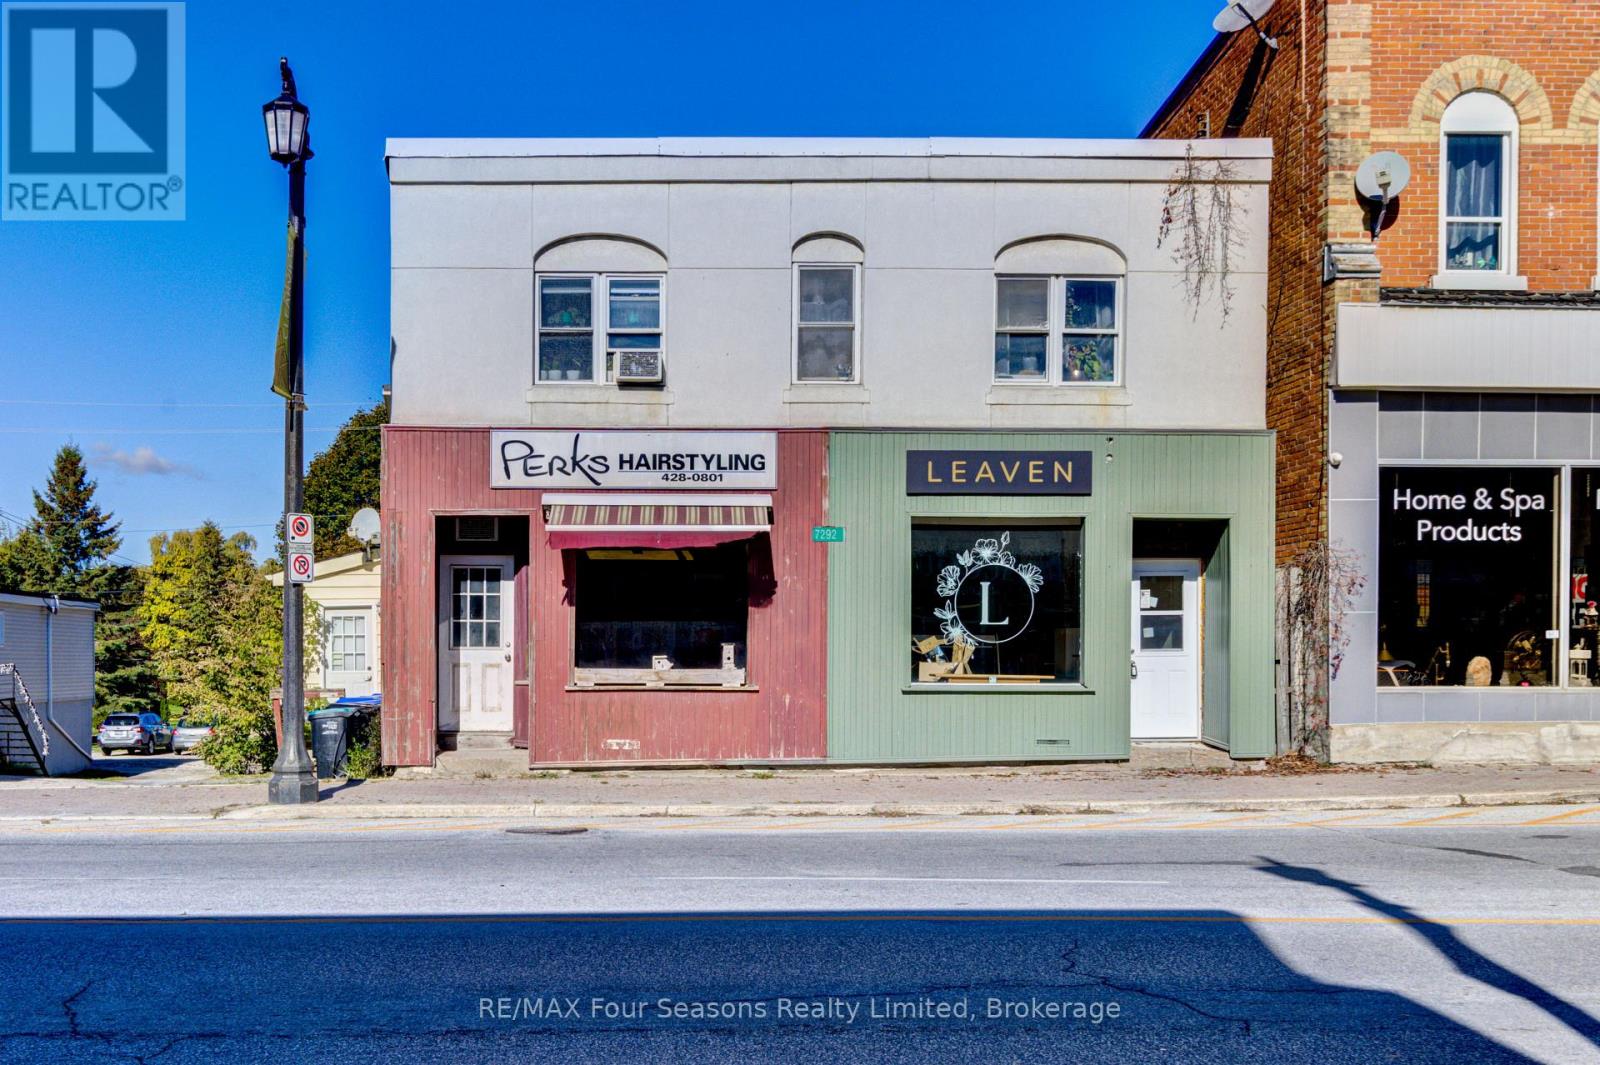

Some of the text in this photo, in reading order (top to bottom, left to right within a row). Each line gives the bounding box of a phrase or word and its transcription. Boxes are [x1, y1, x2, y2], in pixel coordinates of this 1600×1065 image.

[618, 453, 767, 471] HAIRSTYLING
[926, 460, 1074, 483] LEAVEN
[661, 473, 724, 482] 428-0801
[1393, 487, 1545, 517] Home & Spa
[815, 529, 837, 540] 7292
[1417, 518, 1522, 541] Products
[979, 581, 1009, 625] L
